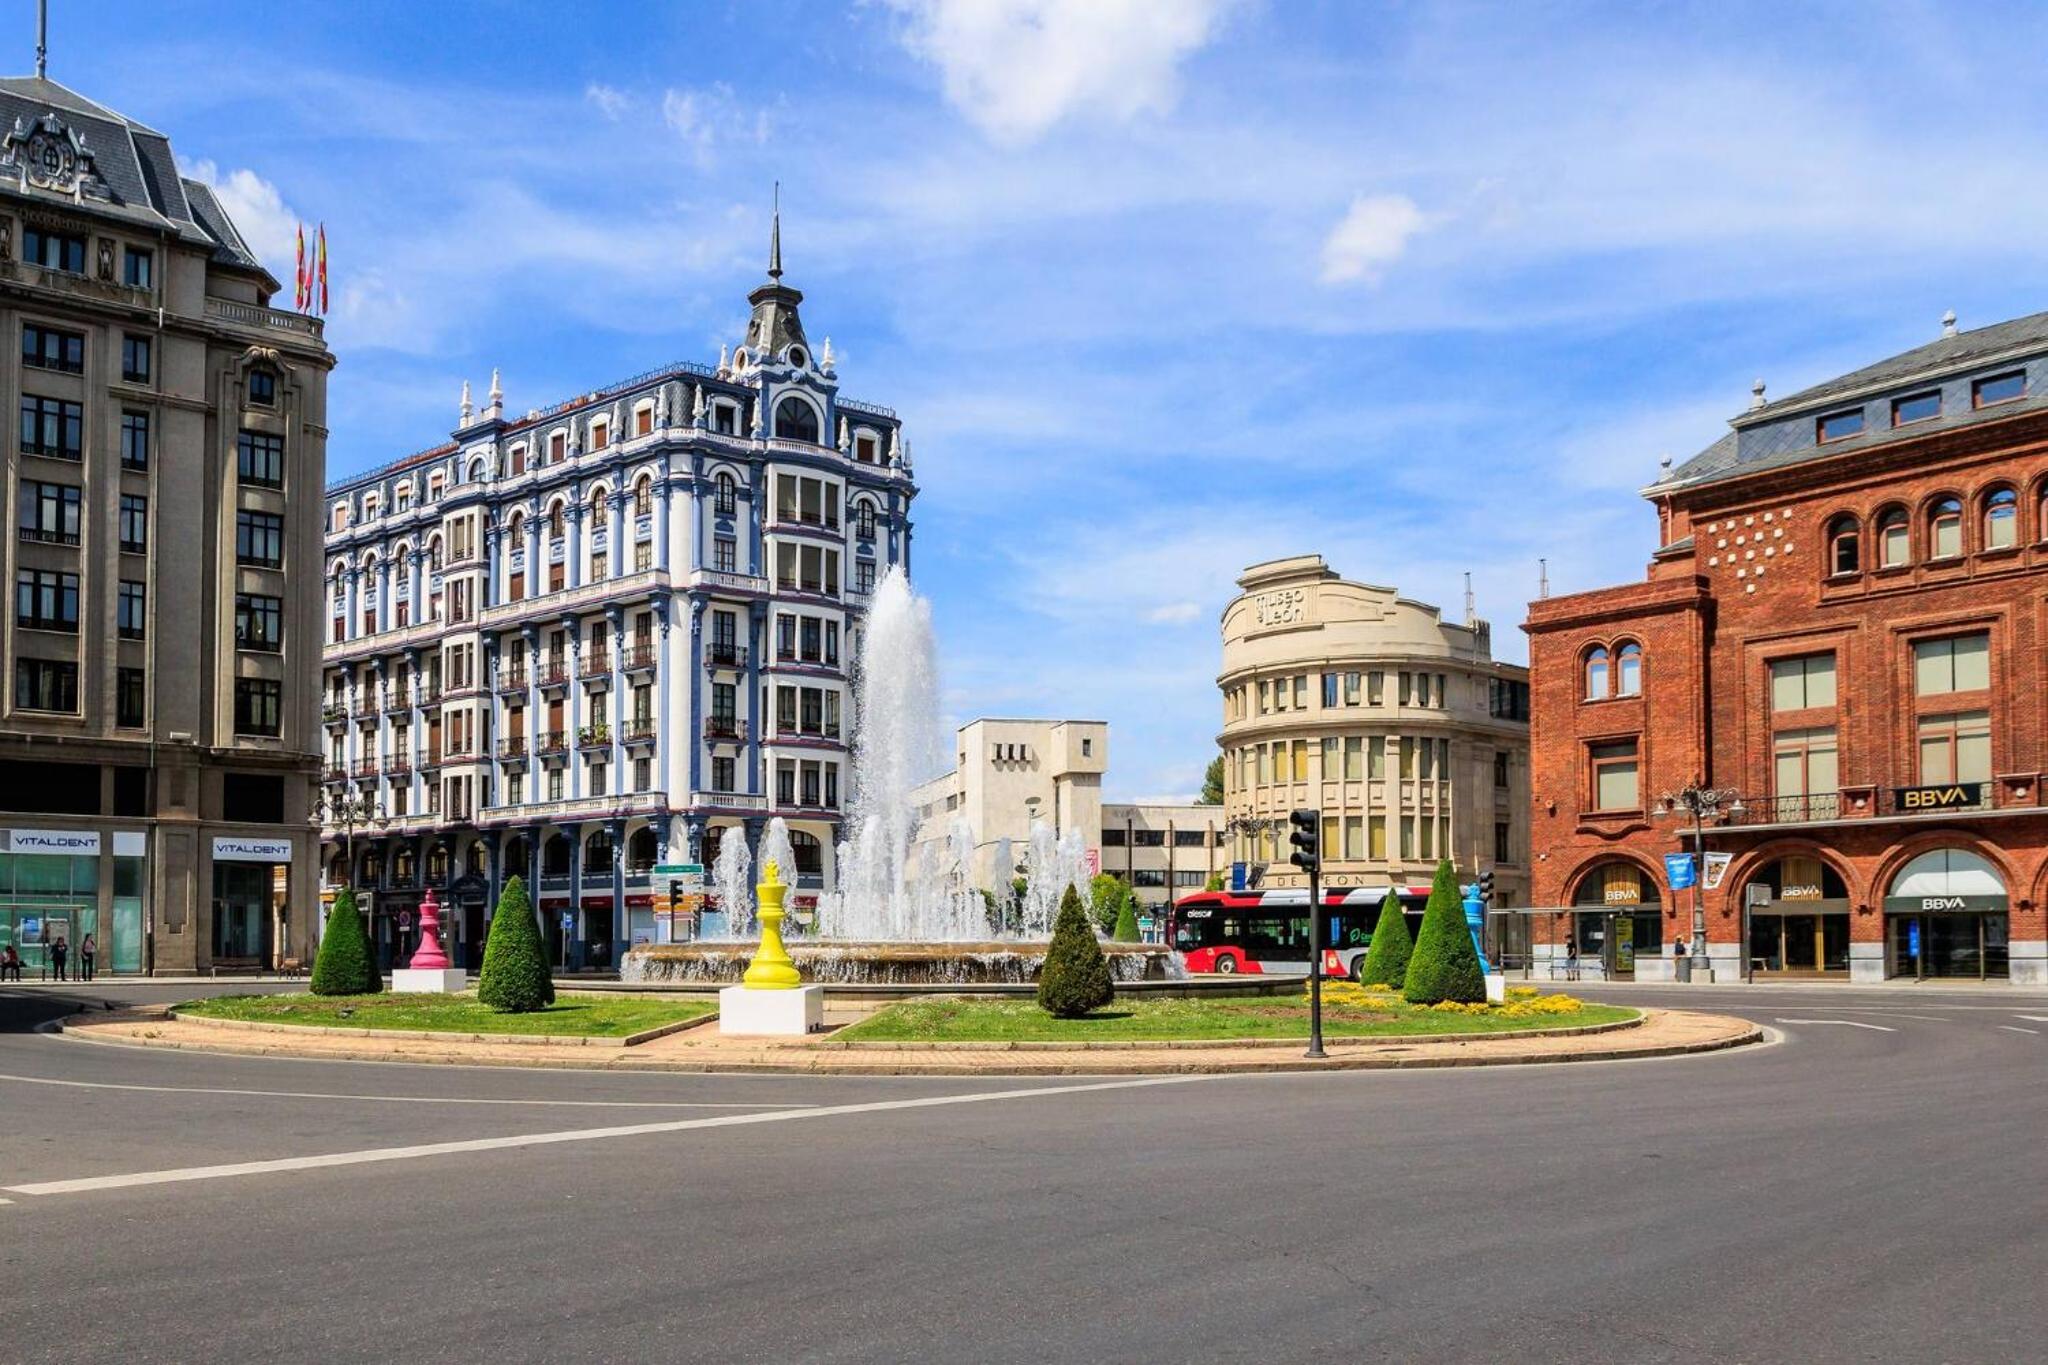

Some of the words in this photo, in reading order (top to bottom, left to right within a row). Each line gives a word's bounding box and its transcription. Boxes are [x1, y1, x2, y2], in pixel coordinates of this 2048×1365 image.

[1904, 786, 1968, 808] BBVA
[15, 837, 98, 848] VITALDENT
[216, 844, 289, 855] VITALDENT
[1277, 875, 1298, 887] DE
[1325, 874, 1365, 886] EON
[1606, 889, 1638, 901] BBVA
[1782, 885, 1820, 897] BBVA
[1922, 896, 1966, 911] BBVA
